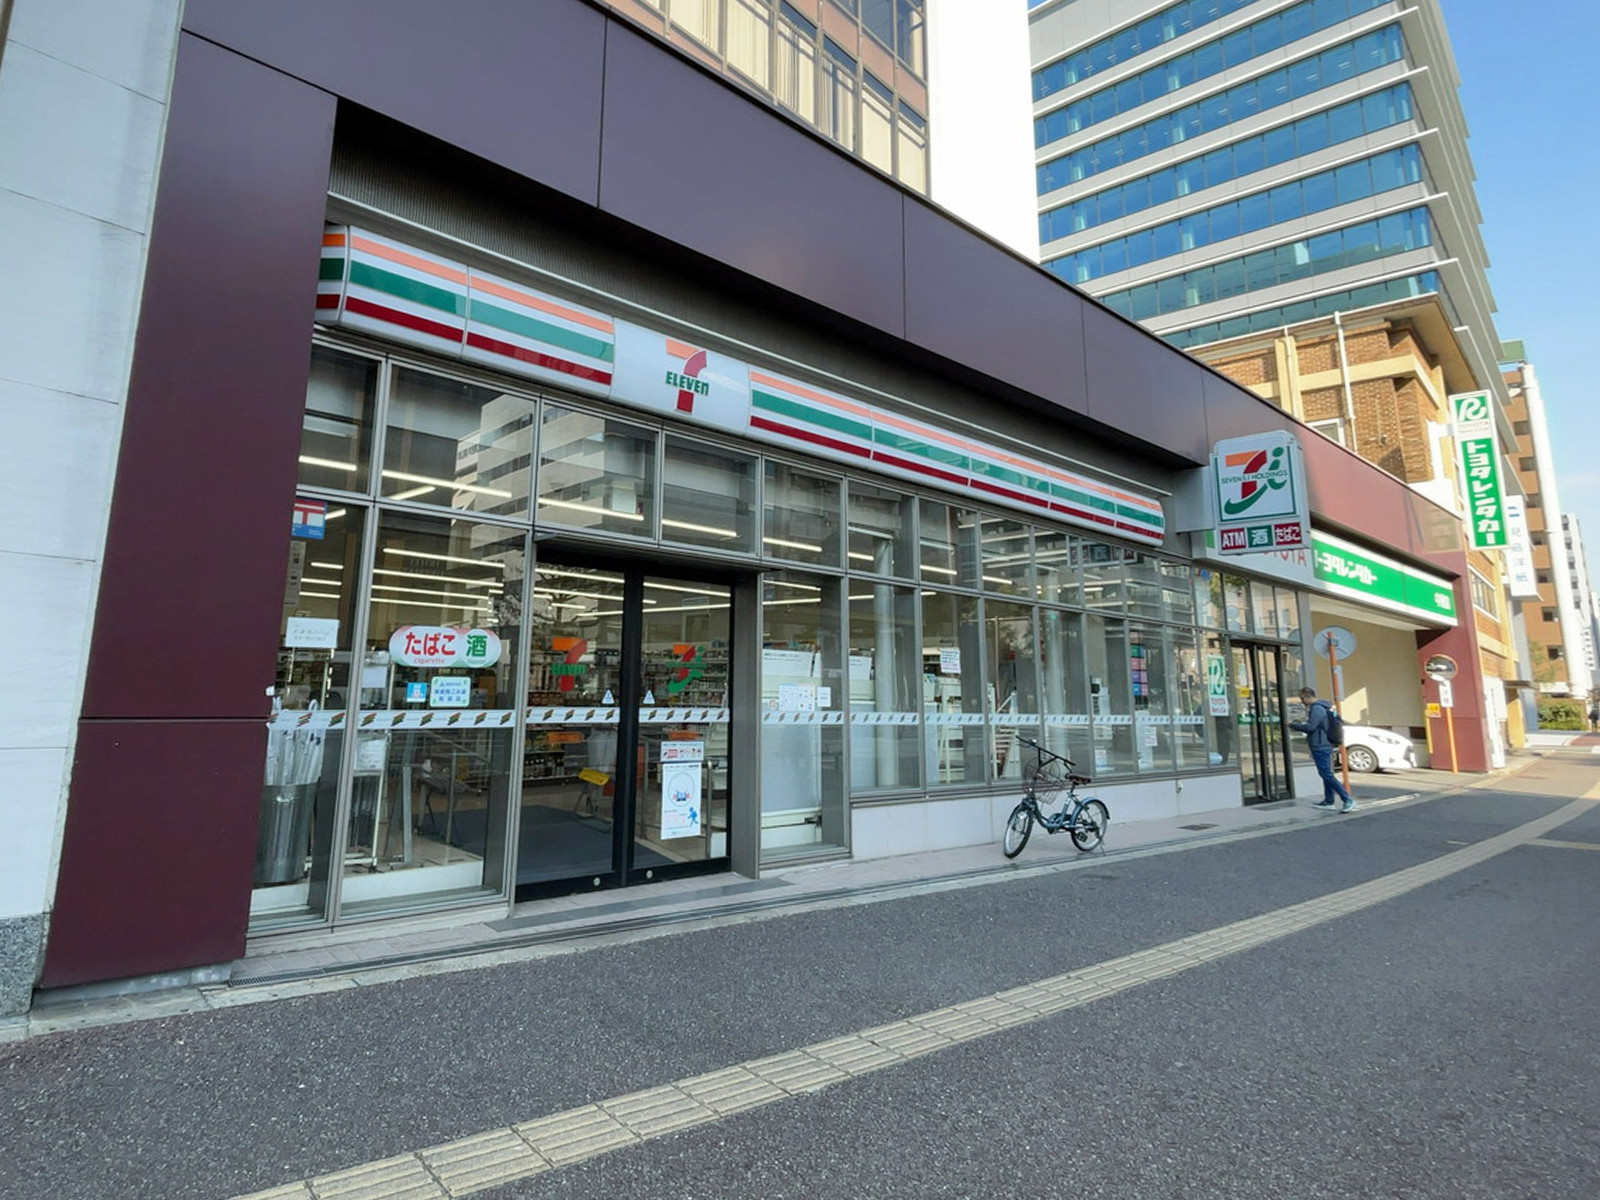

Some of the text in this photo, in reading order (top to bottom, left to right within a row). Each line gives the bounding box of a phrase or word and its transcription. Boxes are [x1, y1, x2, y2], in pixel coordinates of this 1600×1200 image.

[1466, 441, 1501, 544] トヨタレンタカー
[1222, 526, 1301, 548] ATM 酒 たばこ
[1314, 549, 1378, 586] トヨタレンタカー
[404, 632, 488, 657] たばこ 酒
